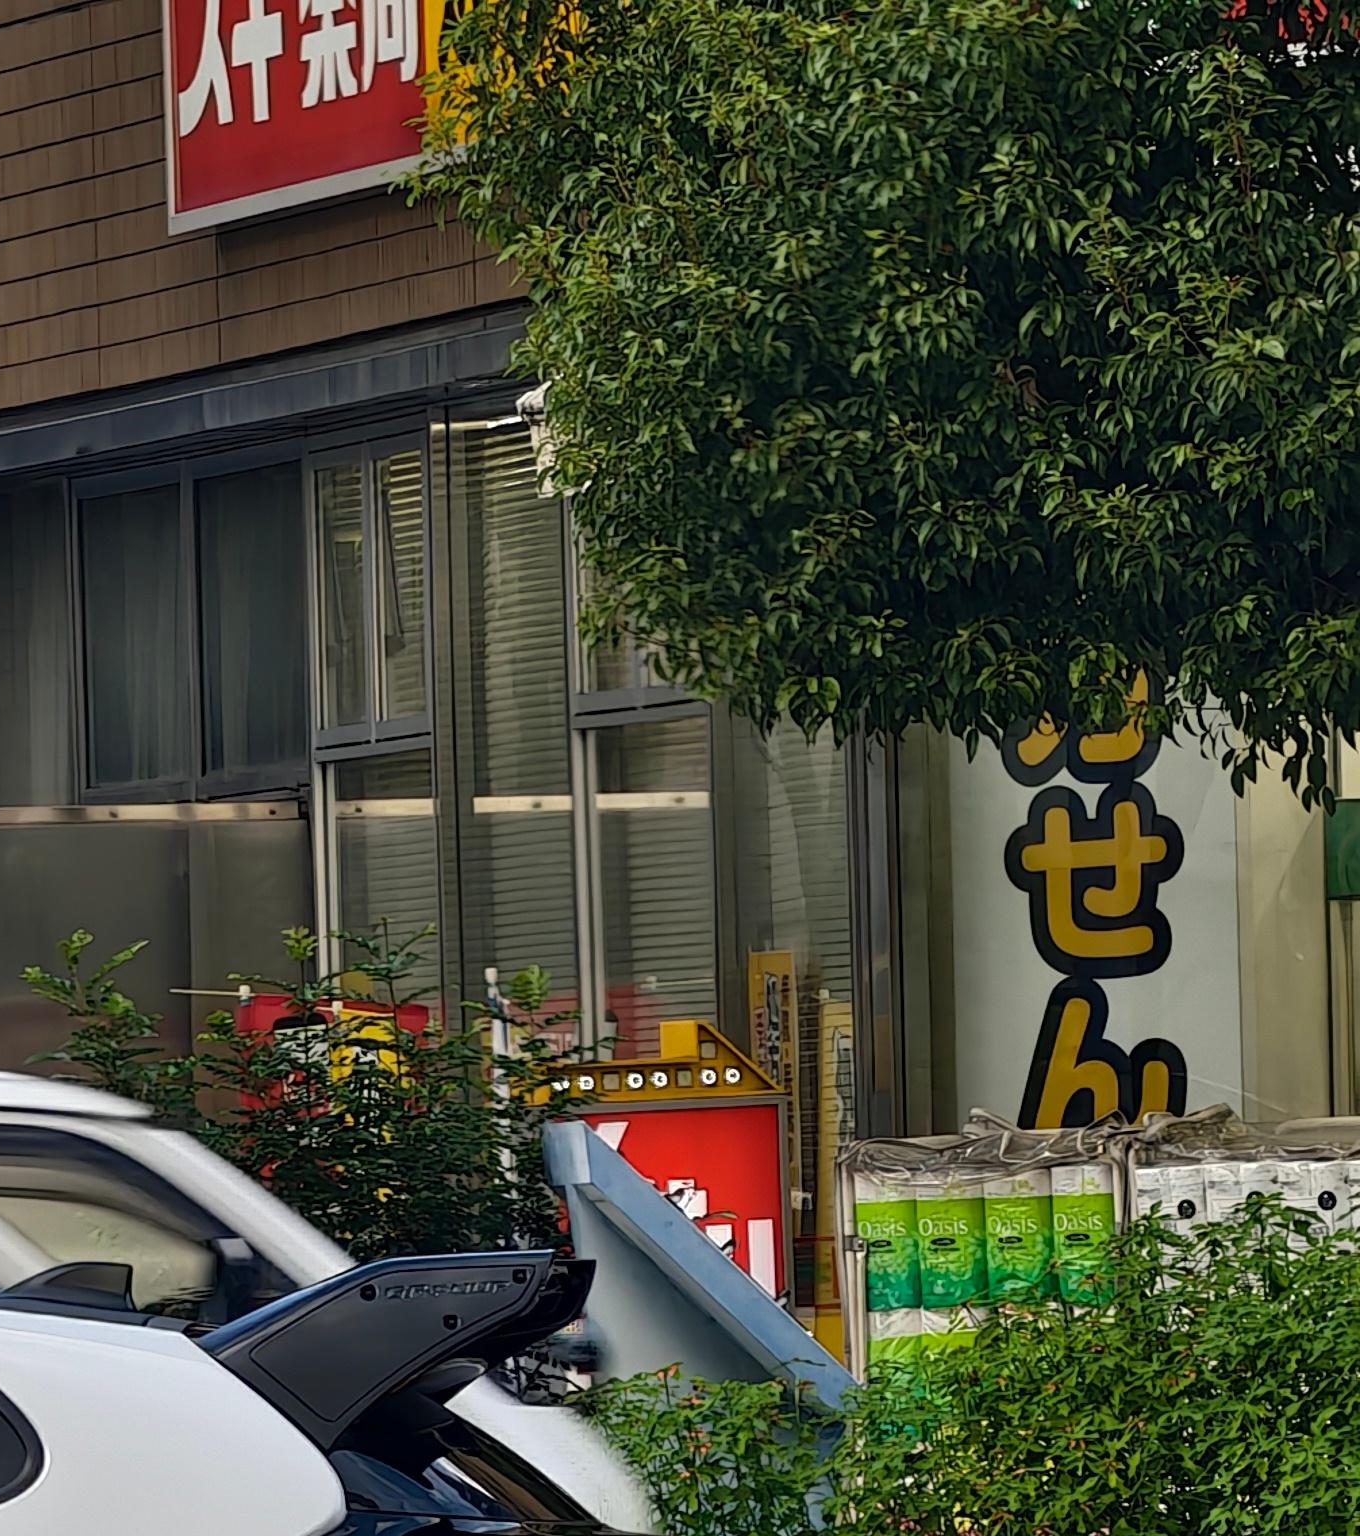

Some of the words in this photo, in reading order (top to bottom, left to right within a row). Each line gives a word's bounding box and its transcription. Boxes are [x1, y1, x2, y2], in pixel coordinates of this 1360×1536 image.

[918, 1214, 969, 1237] Oasis
[987, 1213, 1038, 1235] Oasis
[1053, 1210, 1103, 1233] Oasis
